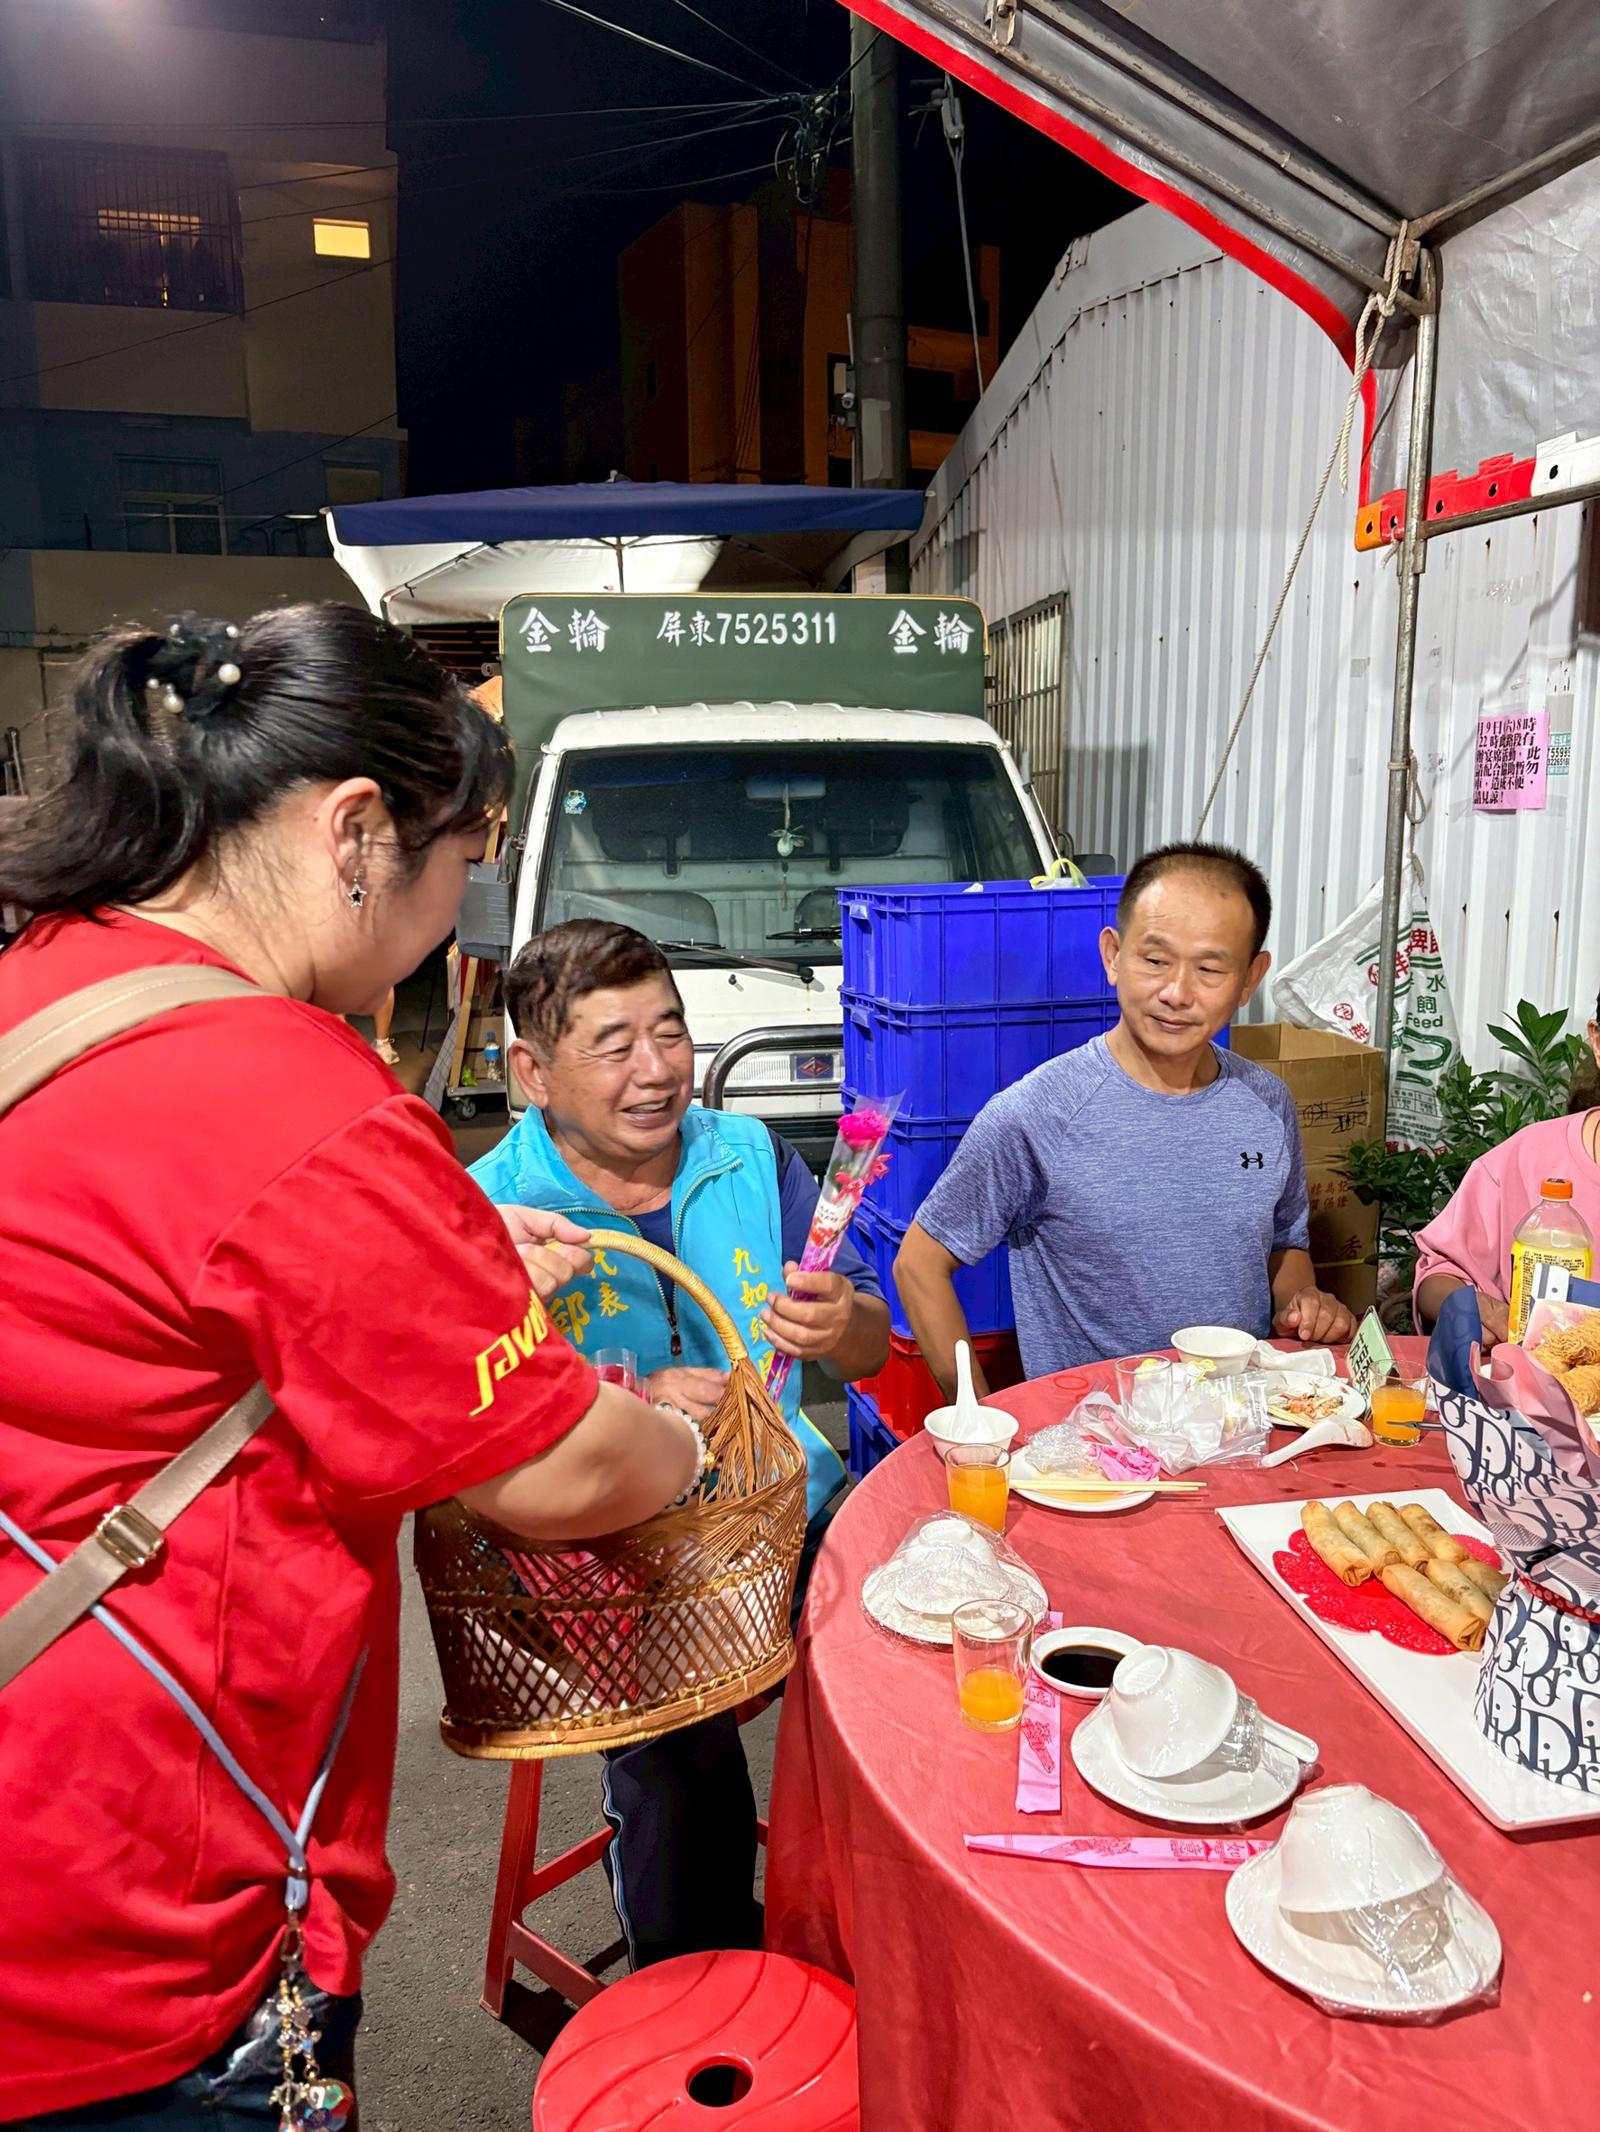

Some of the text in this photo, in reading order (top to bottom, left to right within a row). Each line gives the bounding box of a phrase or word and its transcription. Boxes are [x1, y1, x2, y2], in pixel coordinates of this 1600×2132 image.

[519, 606, 975, 655] 金輪 屏東7525311 金輪
[1406, 1012, 1443, 1029] Feed
